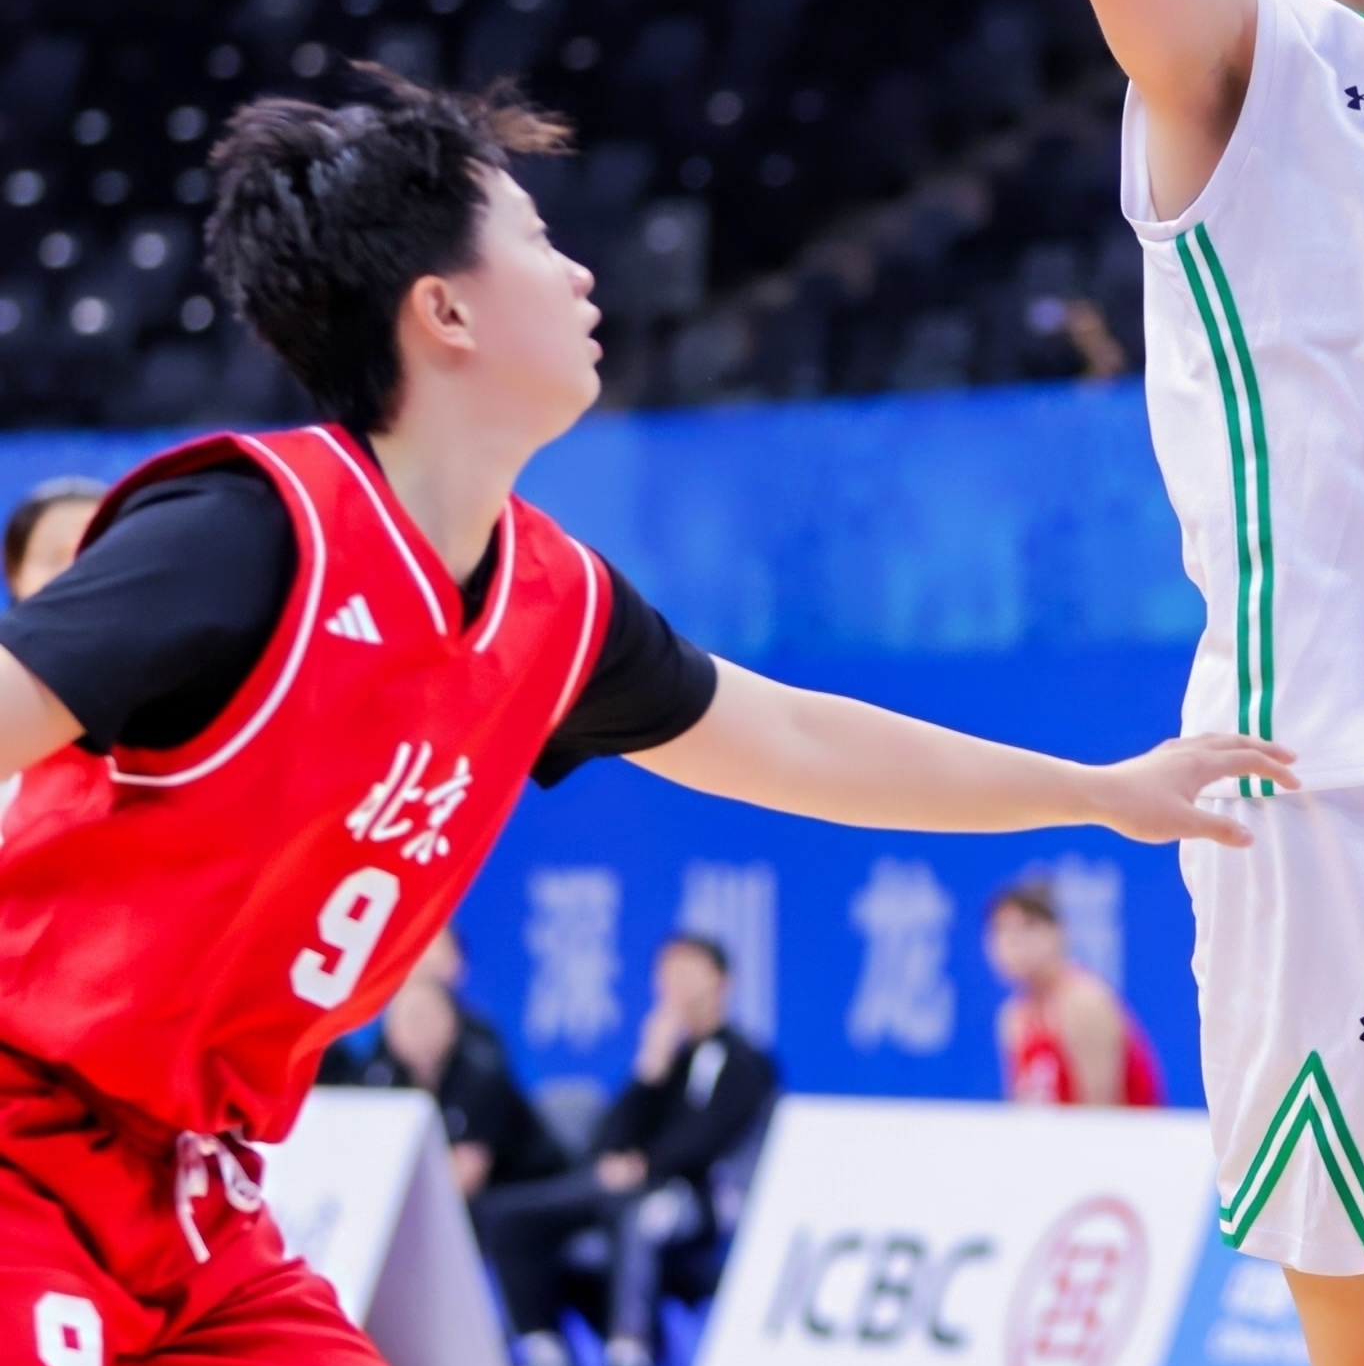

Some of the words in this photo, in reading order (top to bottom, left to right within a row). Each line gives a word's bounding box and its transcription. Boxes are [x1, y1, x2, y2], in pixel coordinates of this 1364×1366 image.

[346, 740, 471, 865] 北京
[290, 866, 399, 1010] 9
[764, 1229, 996, 1354] ICBC
